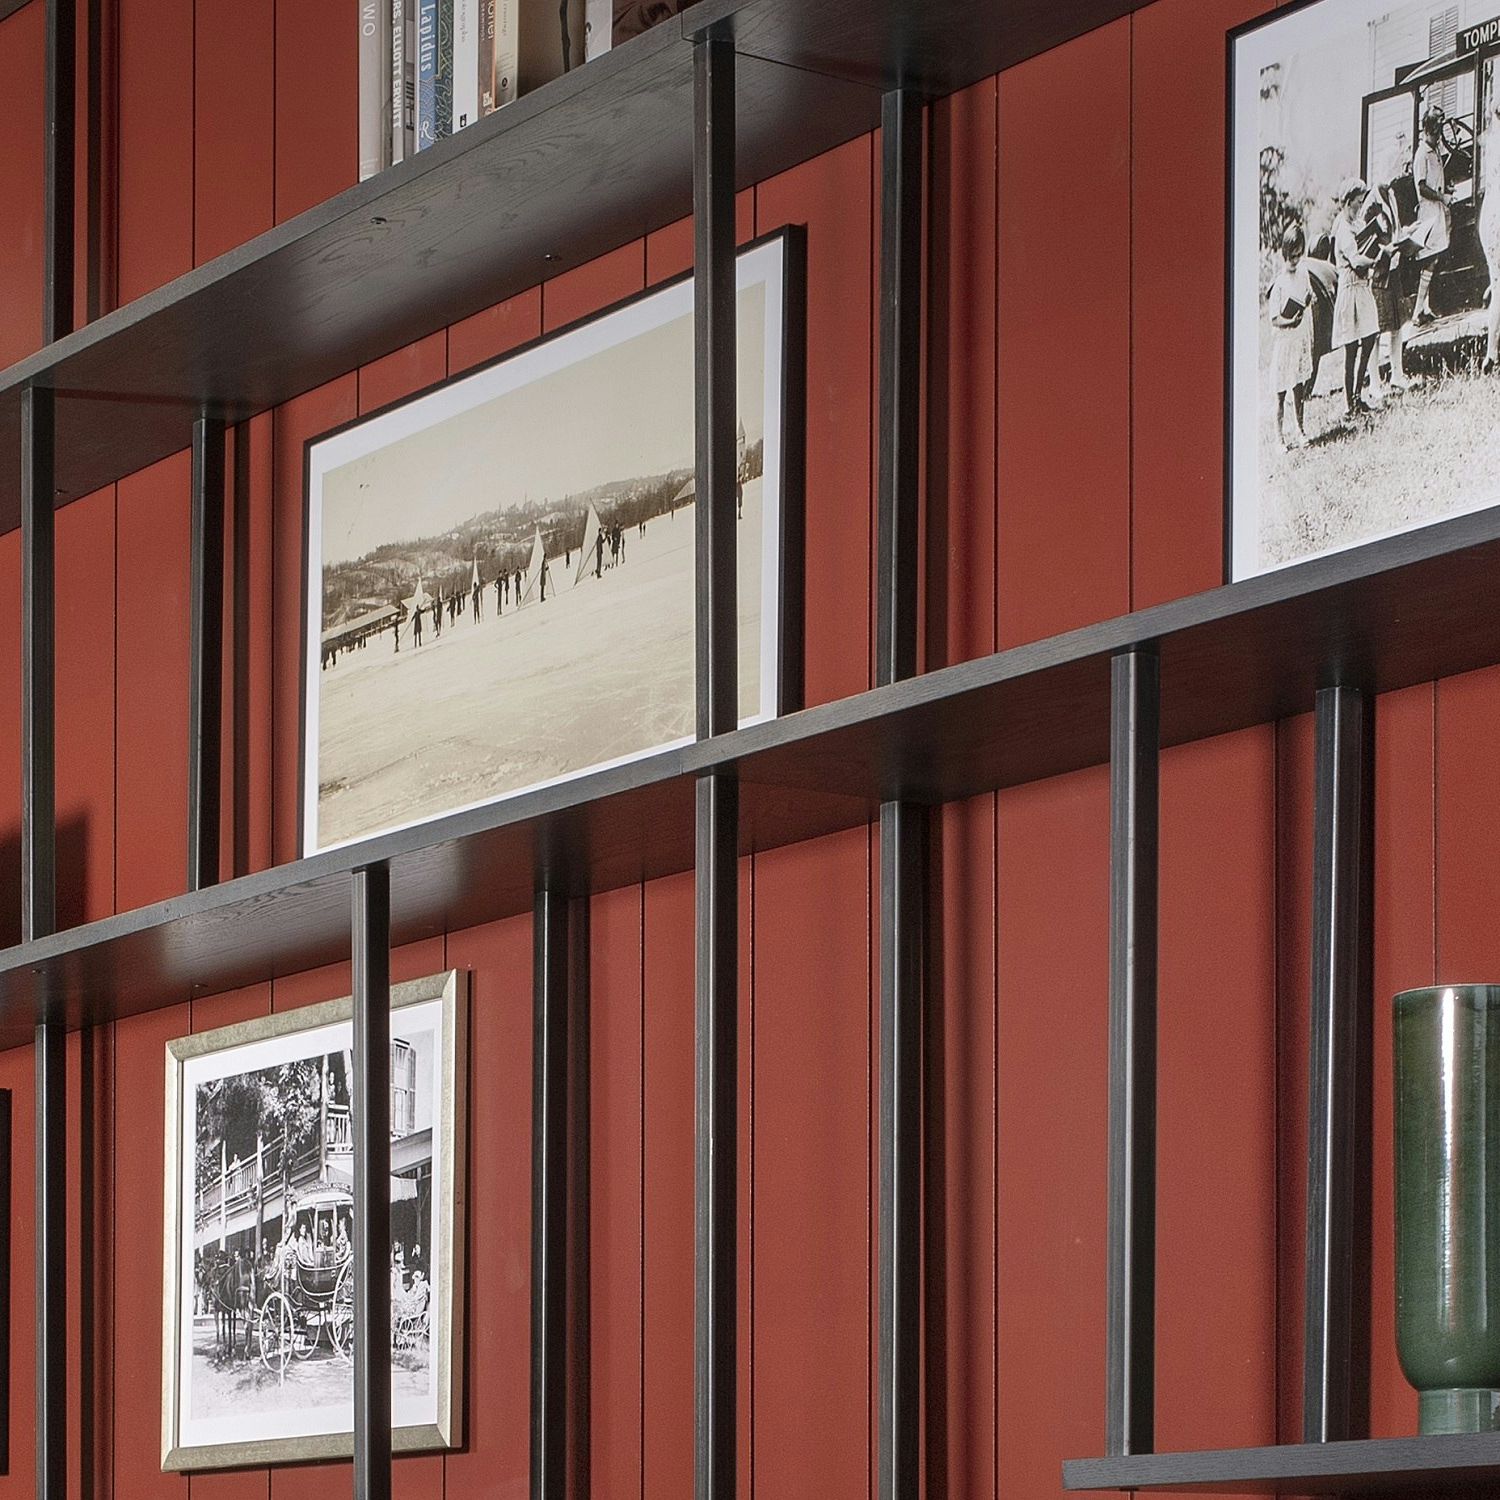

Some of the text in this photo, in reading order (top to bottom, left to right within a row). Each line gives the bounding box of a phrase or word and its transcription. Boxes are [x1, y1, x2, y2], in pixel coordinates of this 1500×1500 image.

[392, 27, 402, 128] ELLIOTT ERWITT
[419, 3, 436, 72] Lapidus
